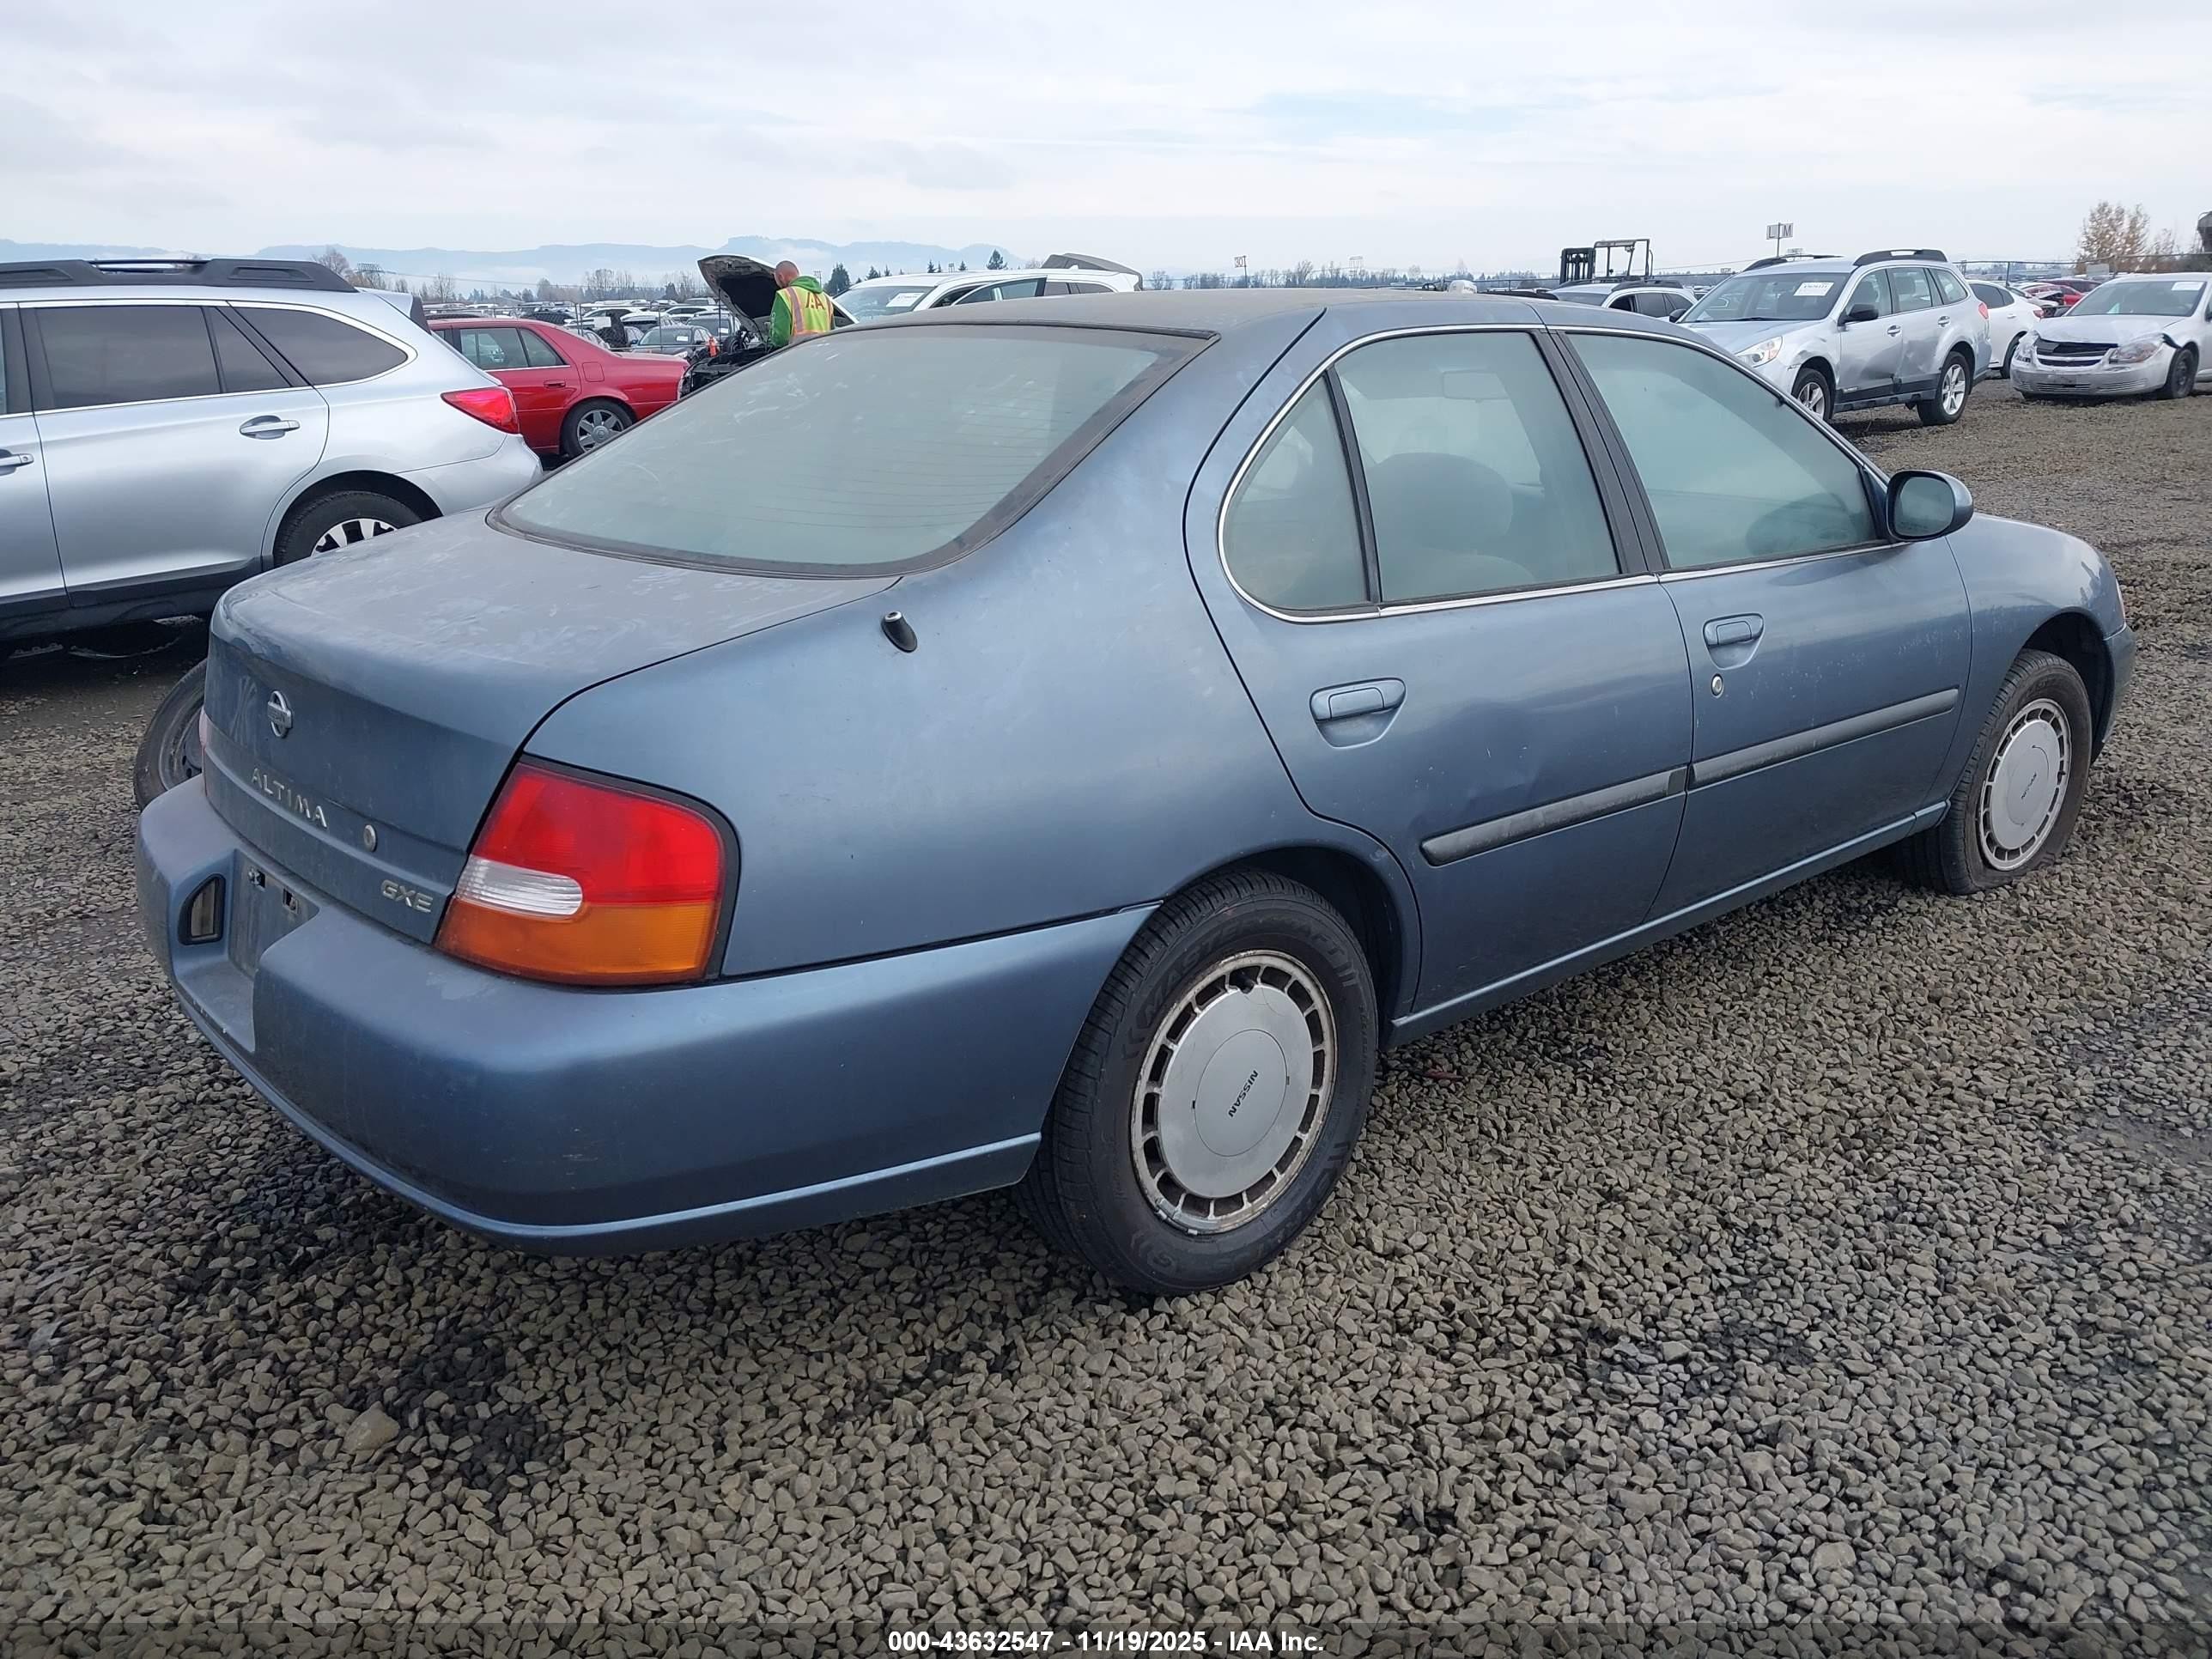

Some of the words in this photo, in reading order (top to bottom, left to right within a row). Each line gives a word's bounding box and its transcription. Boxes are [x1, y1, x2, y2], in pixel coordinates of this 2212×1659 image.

[251, 767, 328, 829] ALTIMA
[380, 878, 434, 914] GXE
[1227, 1069, 1259, 1118] NISSAN
